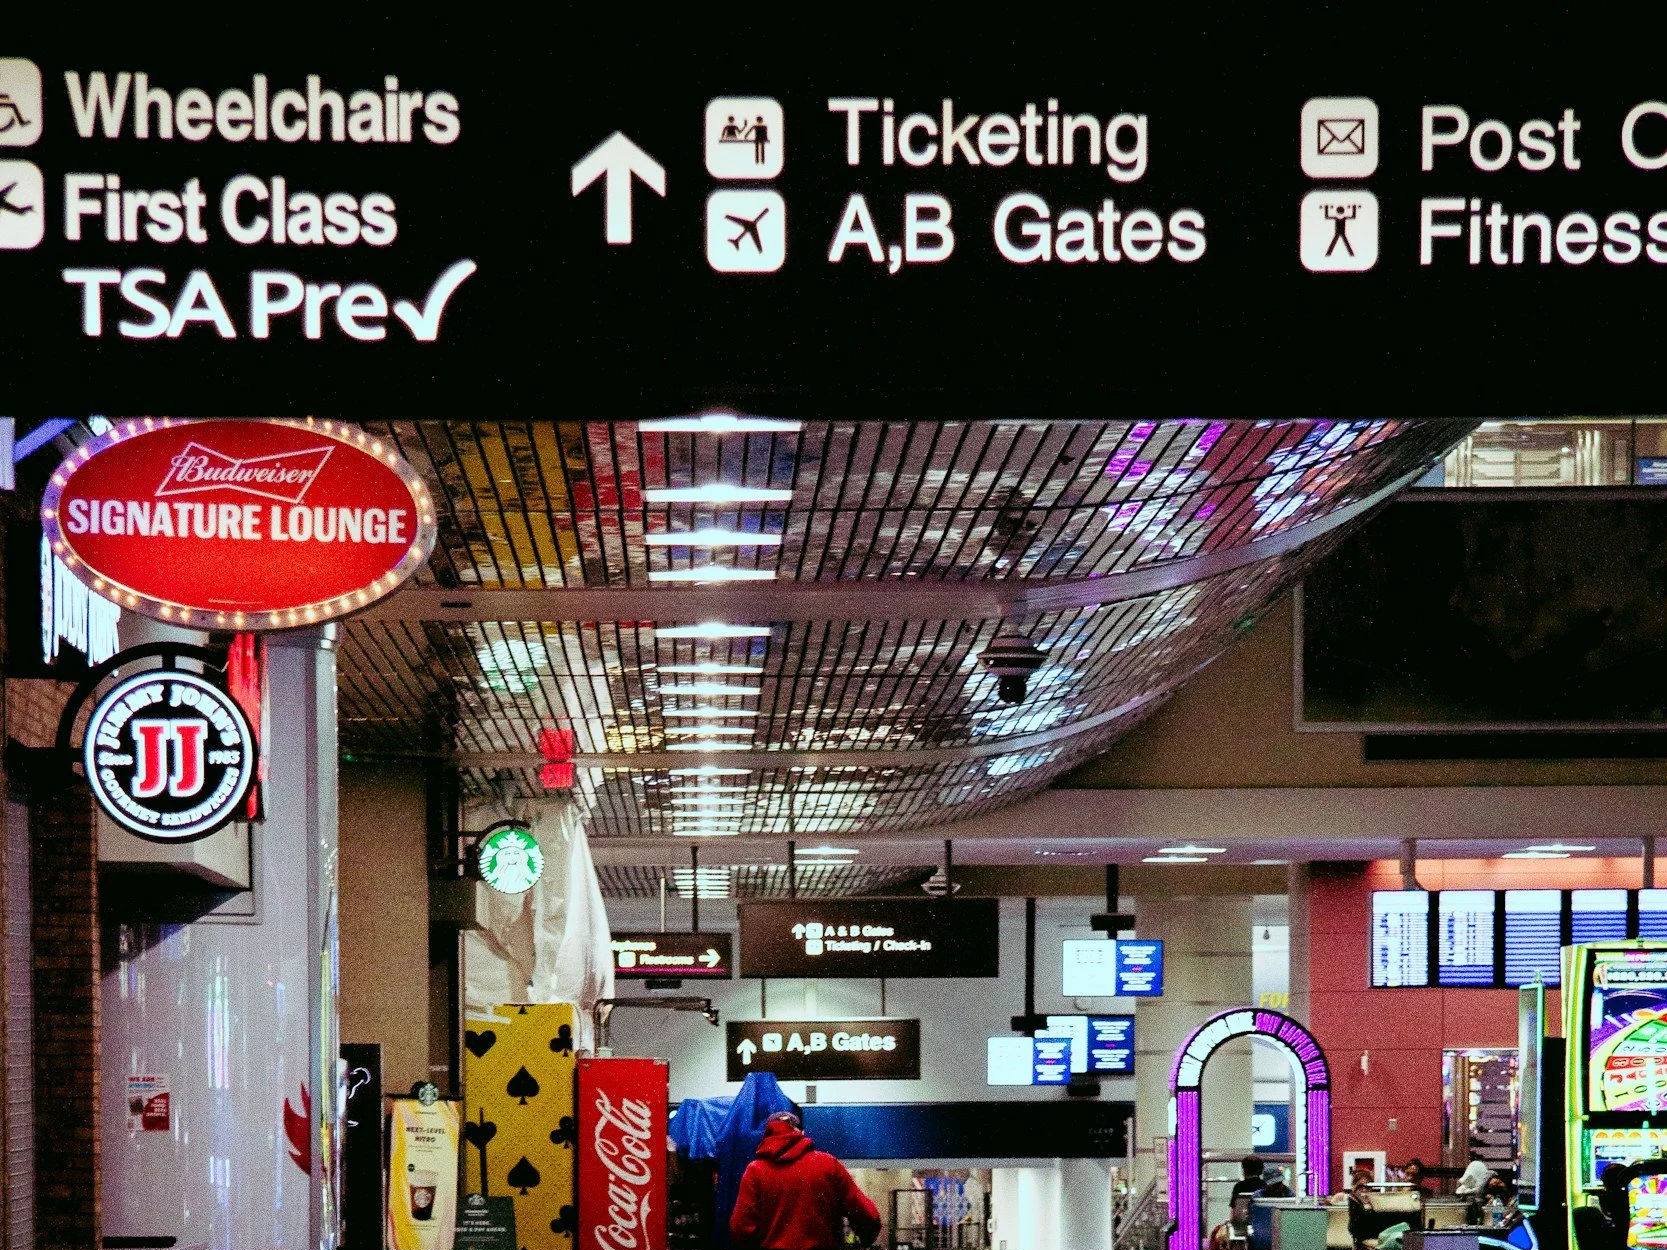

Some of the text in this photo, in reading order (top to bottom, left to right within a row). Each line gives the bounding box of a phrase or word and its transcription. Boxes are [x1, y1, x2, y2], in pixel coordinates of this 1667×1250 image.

[64, 71, 461, 144] Wheelchairs
[827, 97, 1143, 182] Ticketing
[1421, 105, 1582, 172] Post
[64, 173, 398, 247] First Class
[827, 192, 1207, 274] A,B Gates
[63, 267, 237, 339] TSA
[171, 454, 317, 485] Budweiser
[66, 498, 407, 545] SIGNATURE LOUNGE
[97, 684, 164, 750] JIMMY
[131, 719, 208, 798] JJ
[824, 925, 836, 937] A
[849, 925, 861, 937] B
[861, 925, 895, 937] Gates
[786, 1031, 897, 1055] A,B Gates
